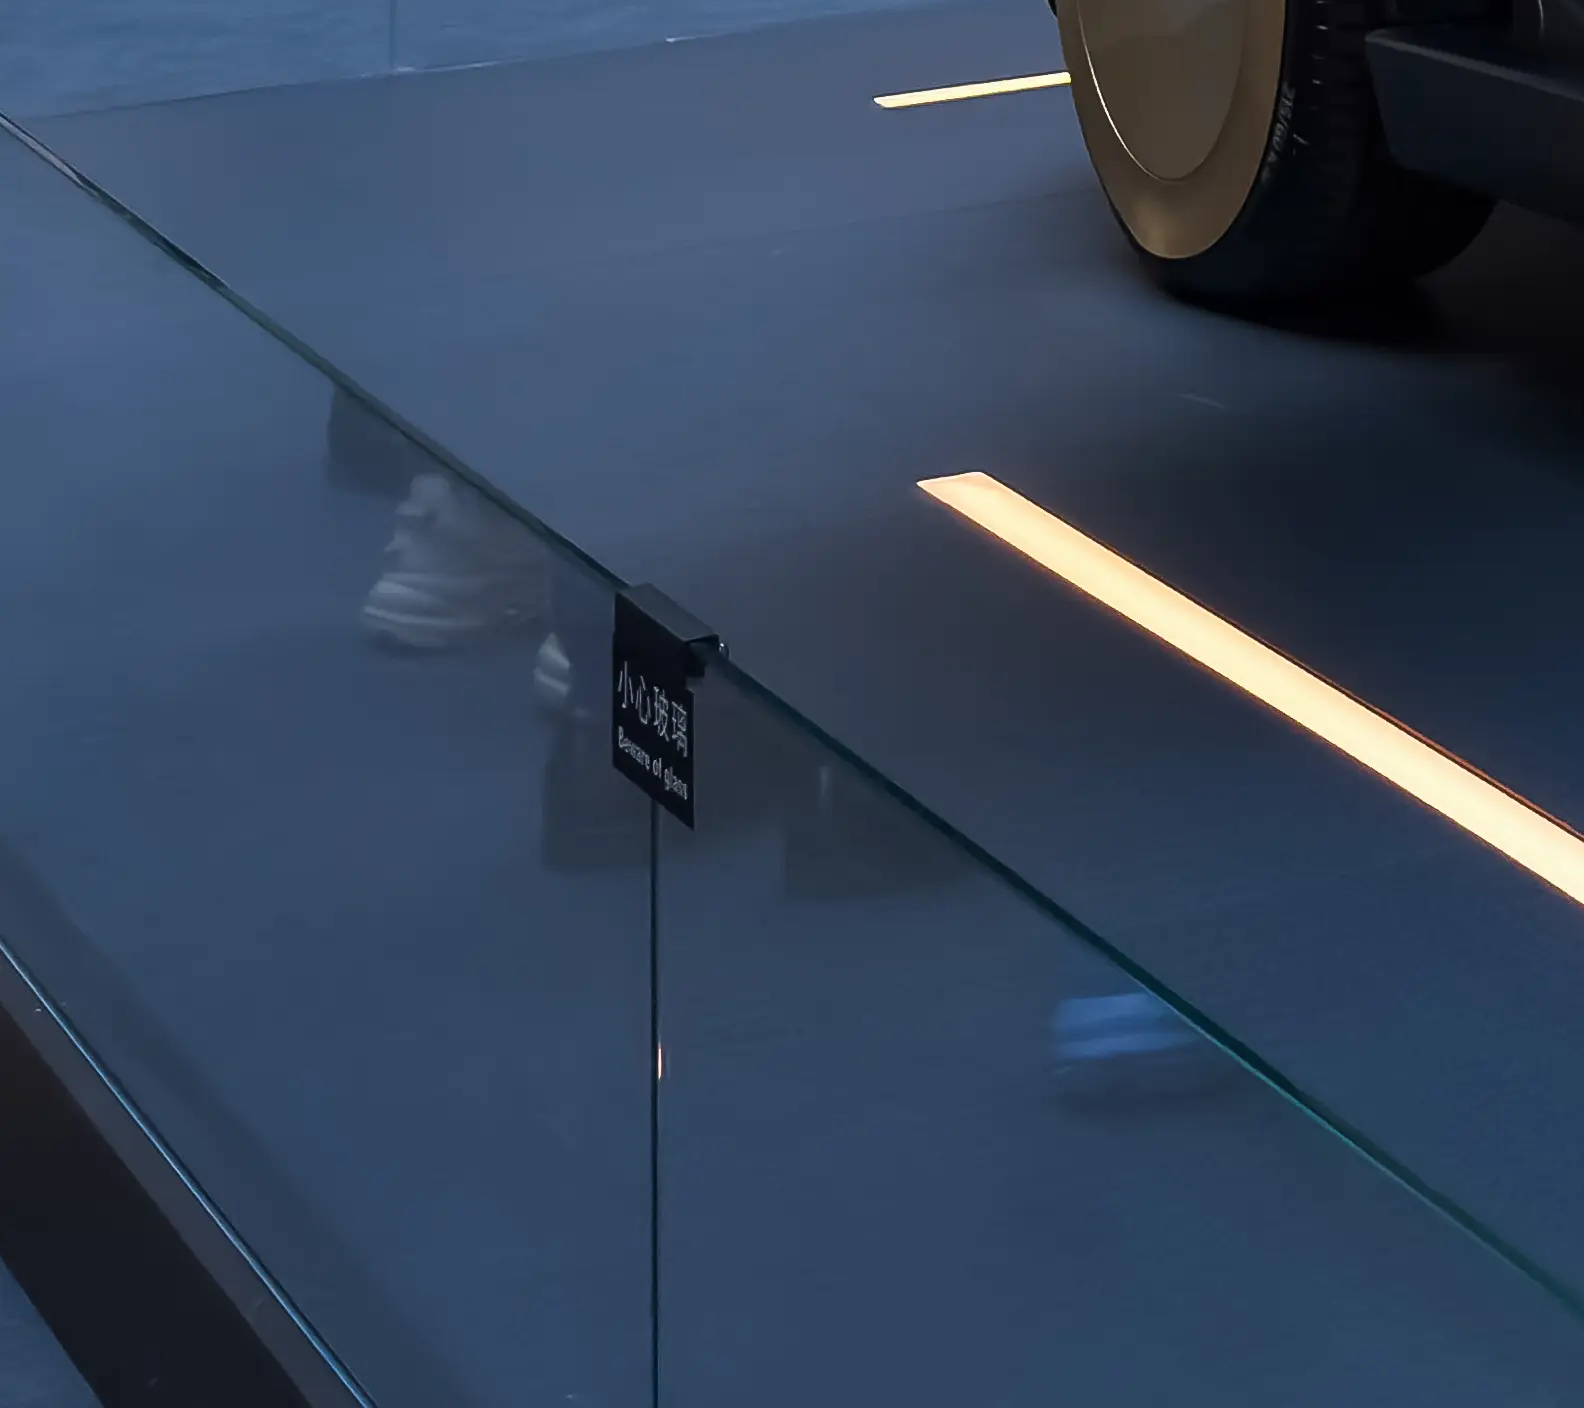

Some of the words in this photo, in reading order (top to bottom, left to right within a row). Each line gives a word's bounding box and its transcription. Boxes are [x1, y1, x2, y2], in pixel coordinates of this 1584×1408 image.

[617, 660, 688, 759] 小心玻璃
[618, 725, 650, 771] Beware
[652, 757, 662, 780] of
